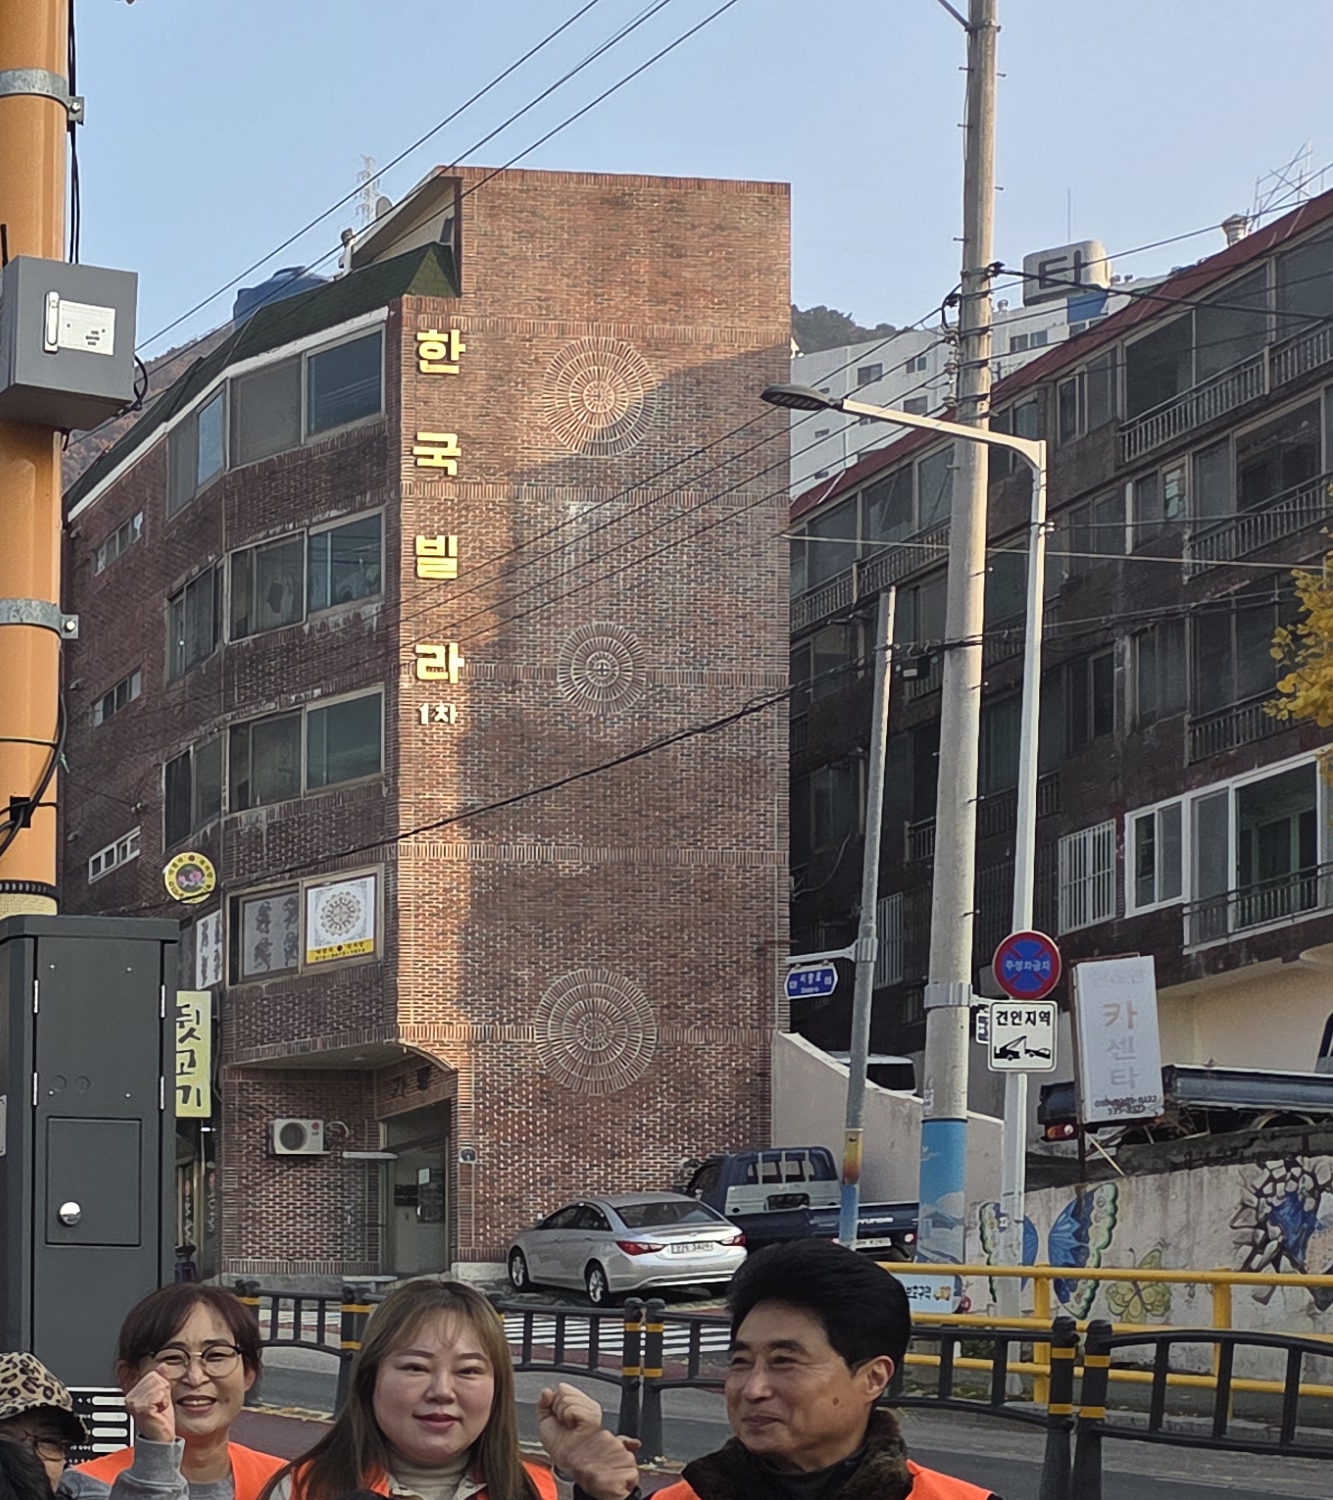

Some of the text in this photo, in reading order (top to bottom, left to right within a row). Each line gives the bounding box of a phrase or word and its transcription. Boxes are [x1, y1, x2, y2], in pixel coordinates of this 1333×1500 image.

[413, 329, 466, 684] 한국빌라
[418, 702, 458, 727] 1차
[995, 1010, 1051, 1027] 견인지역
[1102, 1000, 1141, 1090] 카센타
